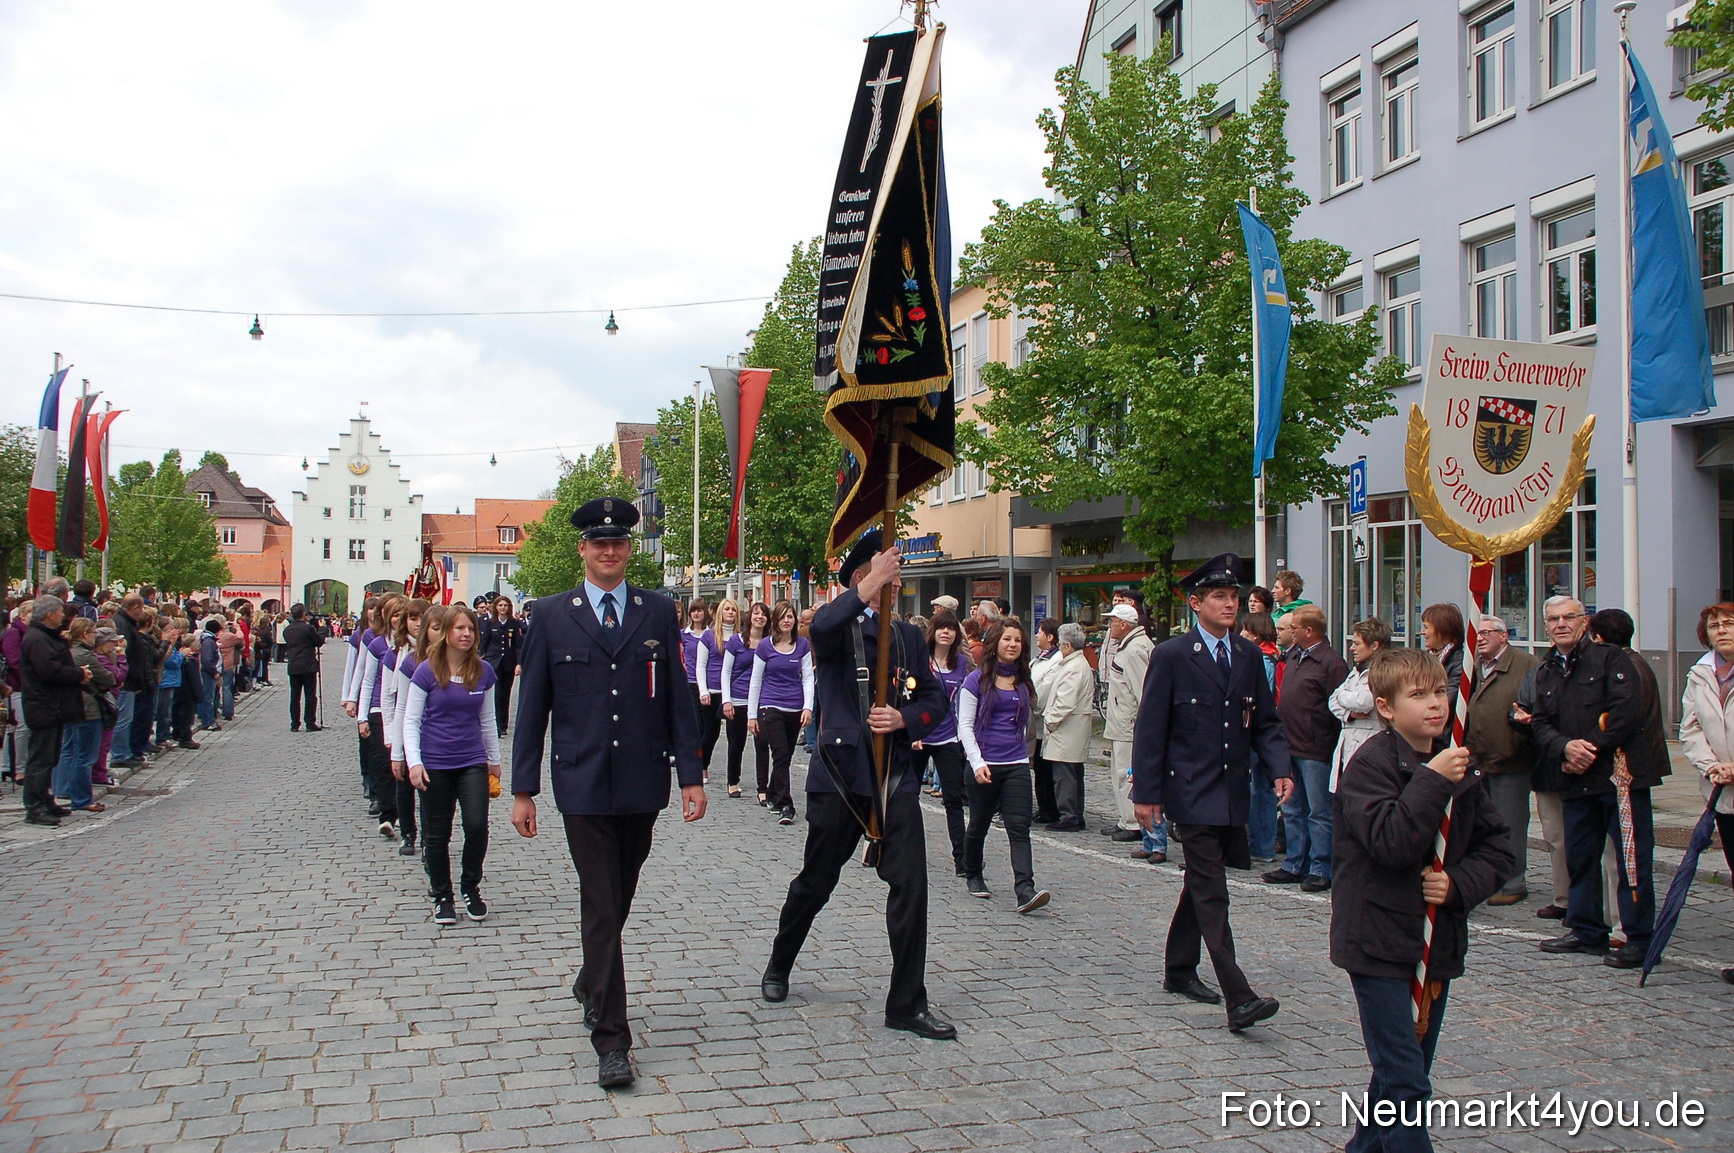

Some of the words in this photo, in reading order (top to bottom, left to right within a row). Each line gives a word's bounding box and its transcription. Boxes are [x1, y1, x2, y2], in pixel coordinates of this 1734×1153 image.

[1440, 346, 1490, 382] Freiw.
[1493, 351, 1587, 391] Feuerwehr
[1445, 397, 1470, 428] 18
[1352, 468, 1363, 508] P
[222, 590, 261, 598] Sparkasse
